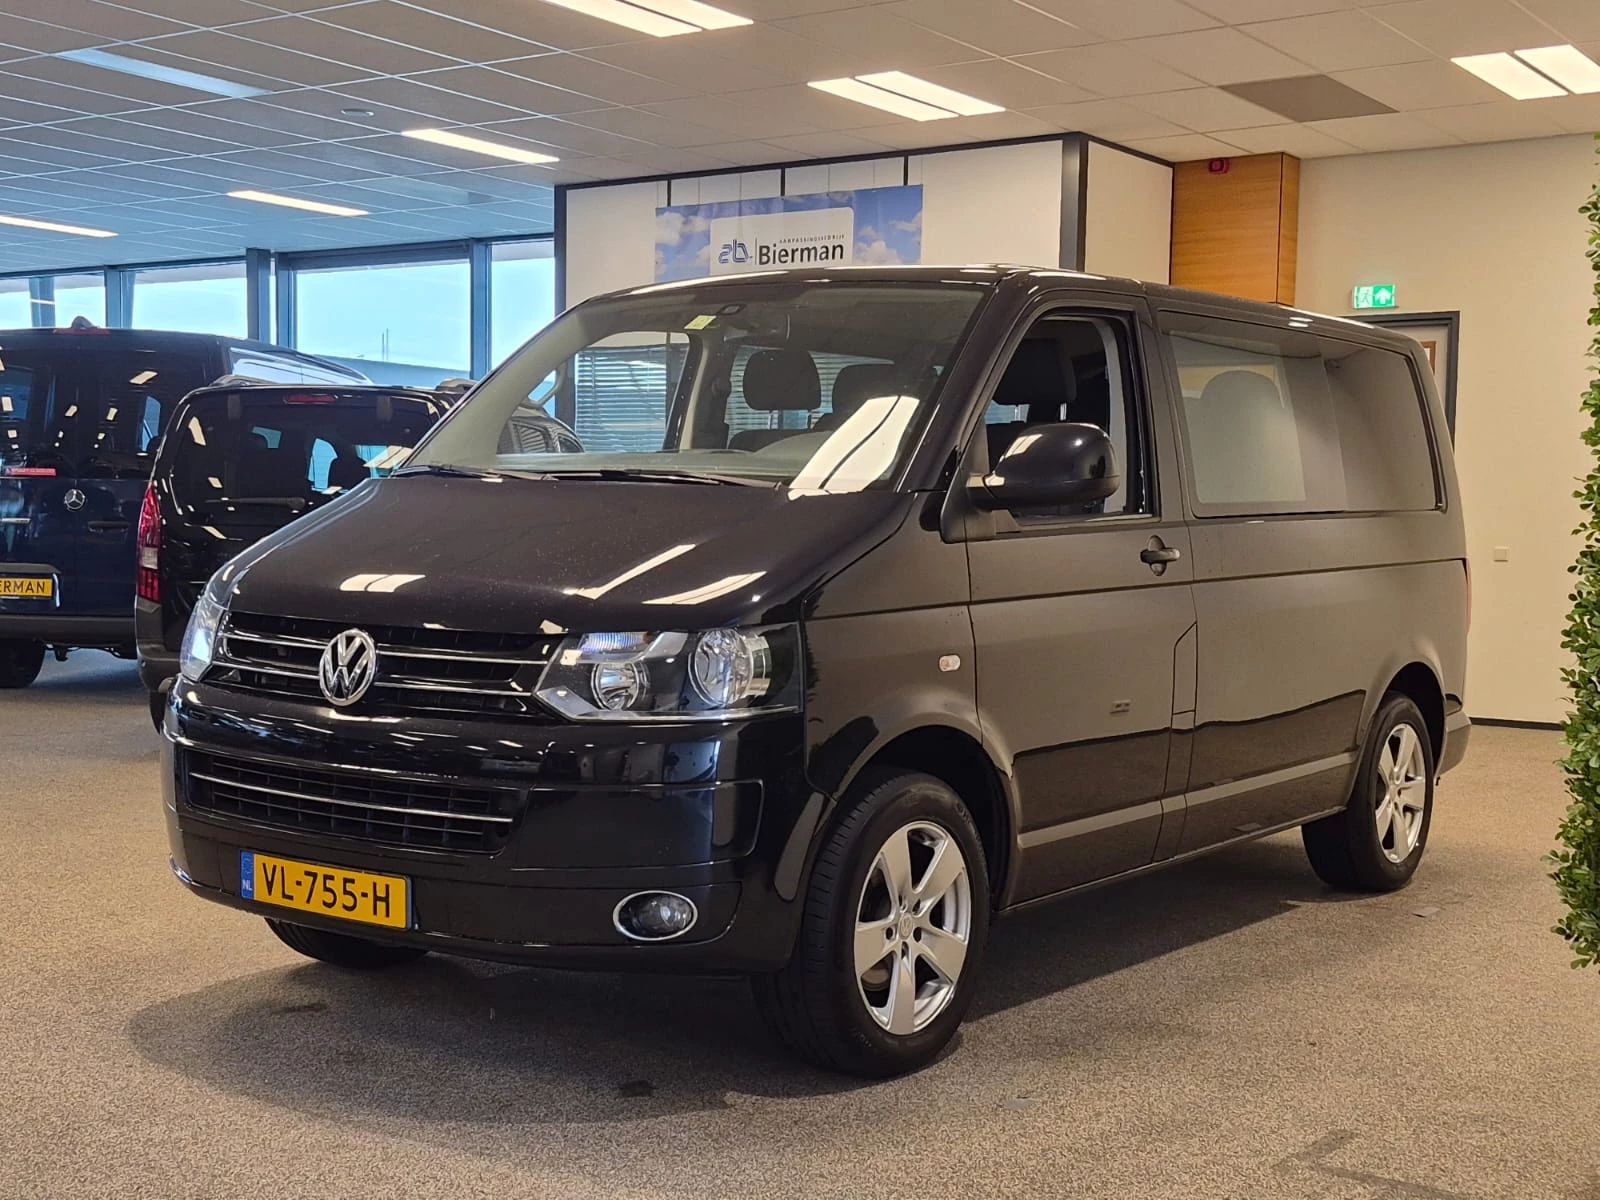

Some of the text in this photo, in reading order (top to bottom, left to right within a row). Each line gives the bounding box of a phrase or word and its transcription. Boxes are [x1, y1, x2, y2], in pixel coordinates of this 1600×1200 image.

[759, 243, 844, 265] Bierman
[242, 879, 253, 891] NL
[262, 862, 390, 918] VL-755-H
